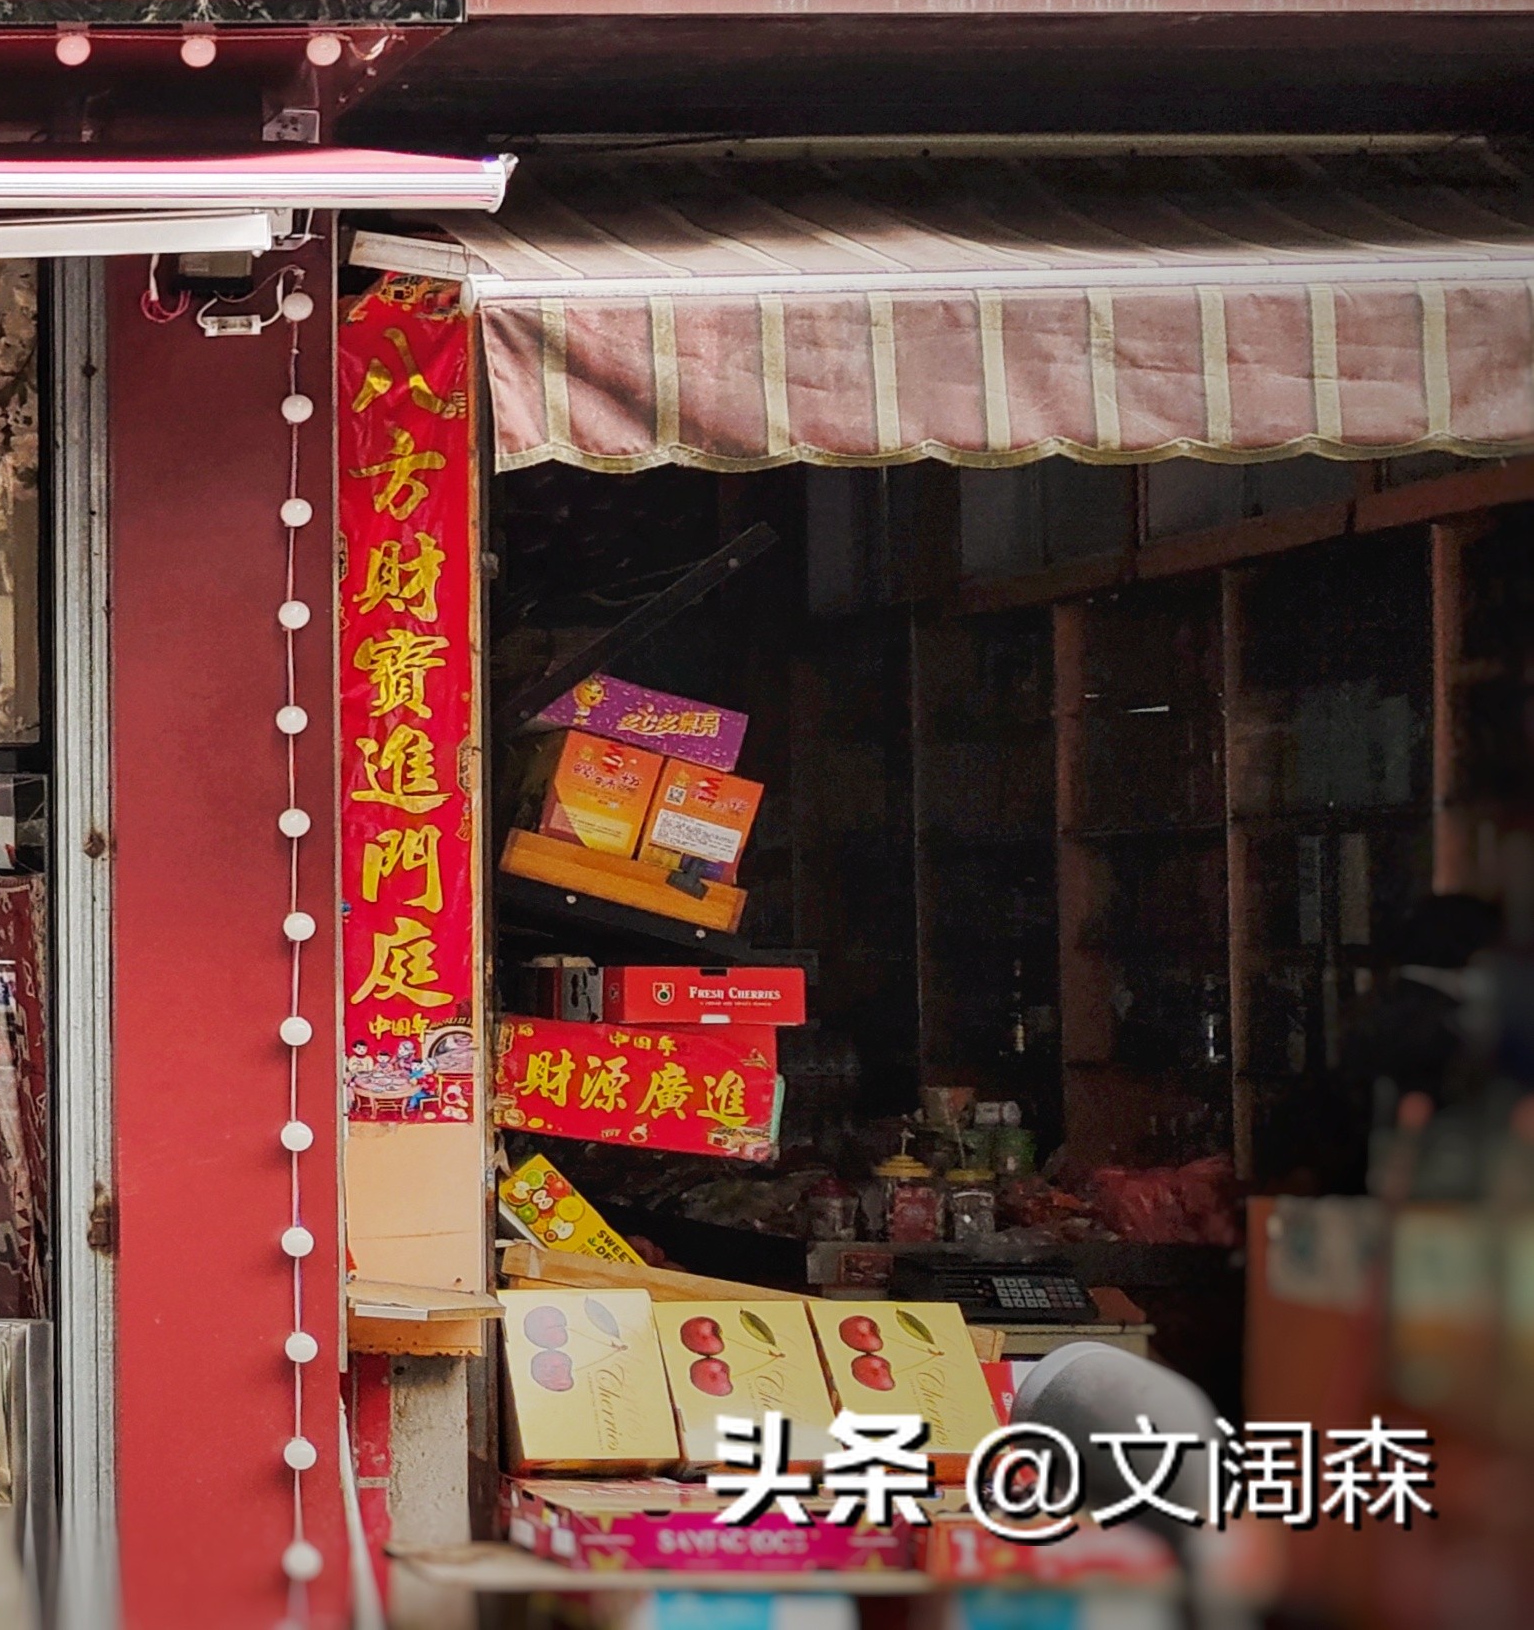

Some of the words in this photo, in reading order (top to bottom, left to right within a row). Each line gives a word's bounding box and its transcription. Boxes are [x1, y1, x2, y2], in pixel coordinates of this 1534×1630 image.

[349, 327, 454, 1008] 八方財寶進門庭
